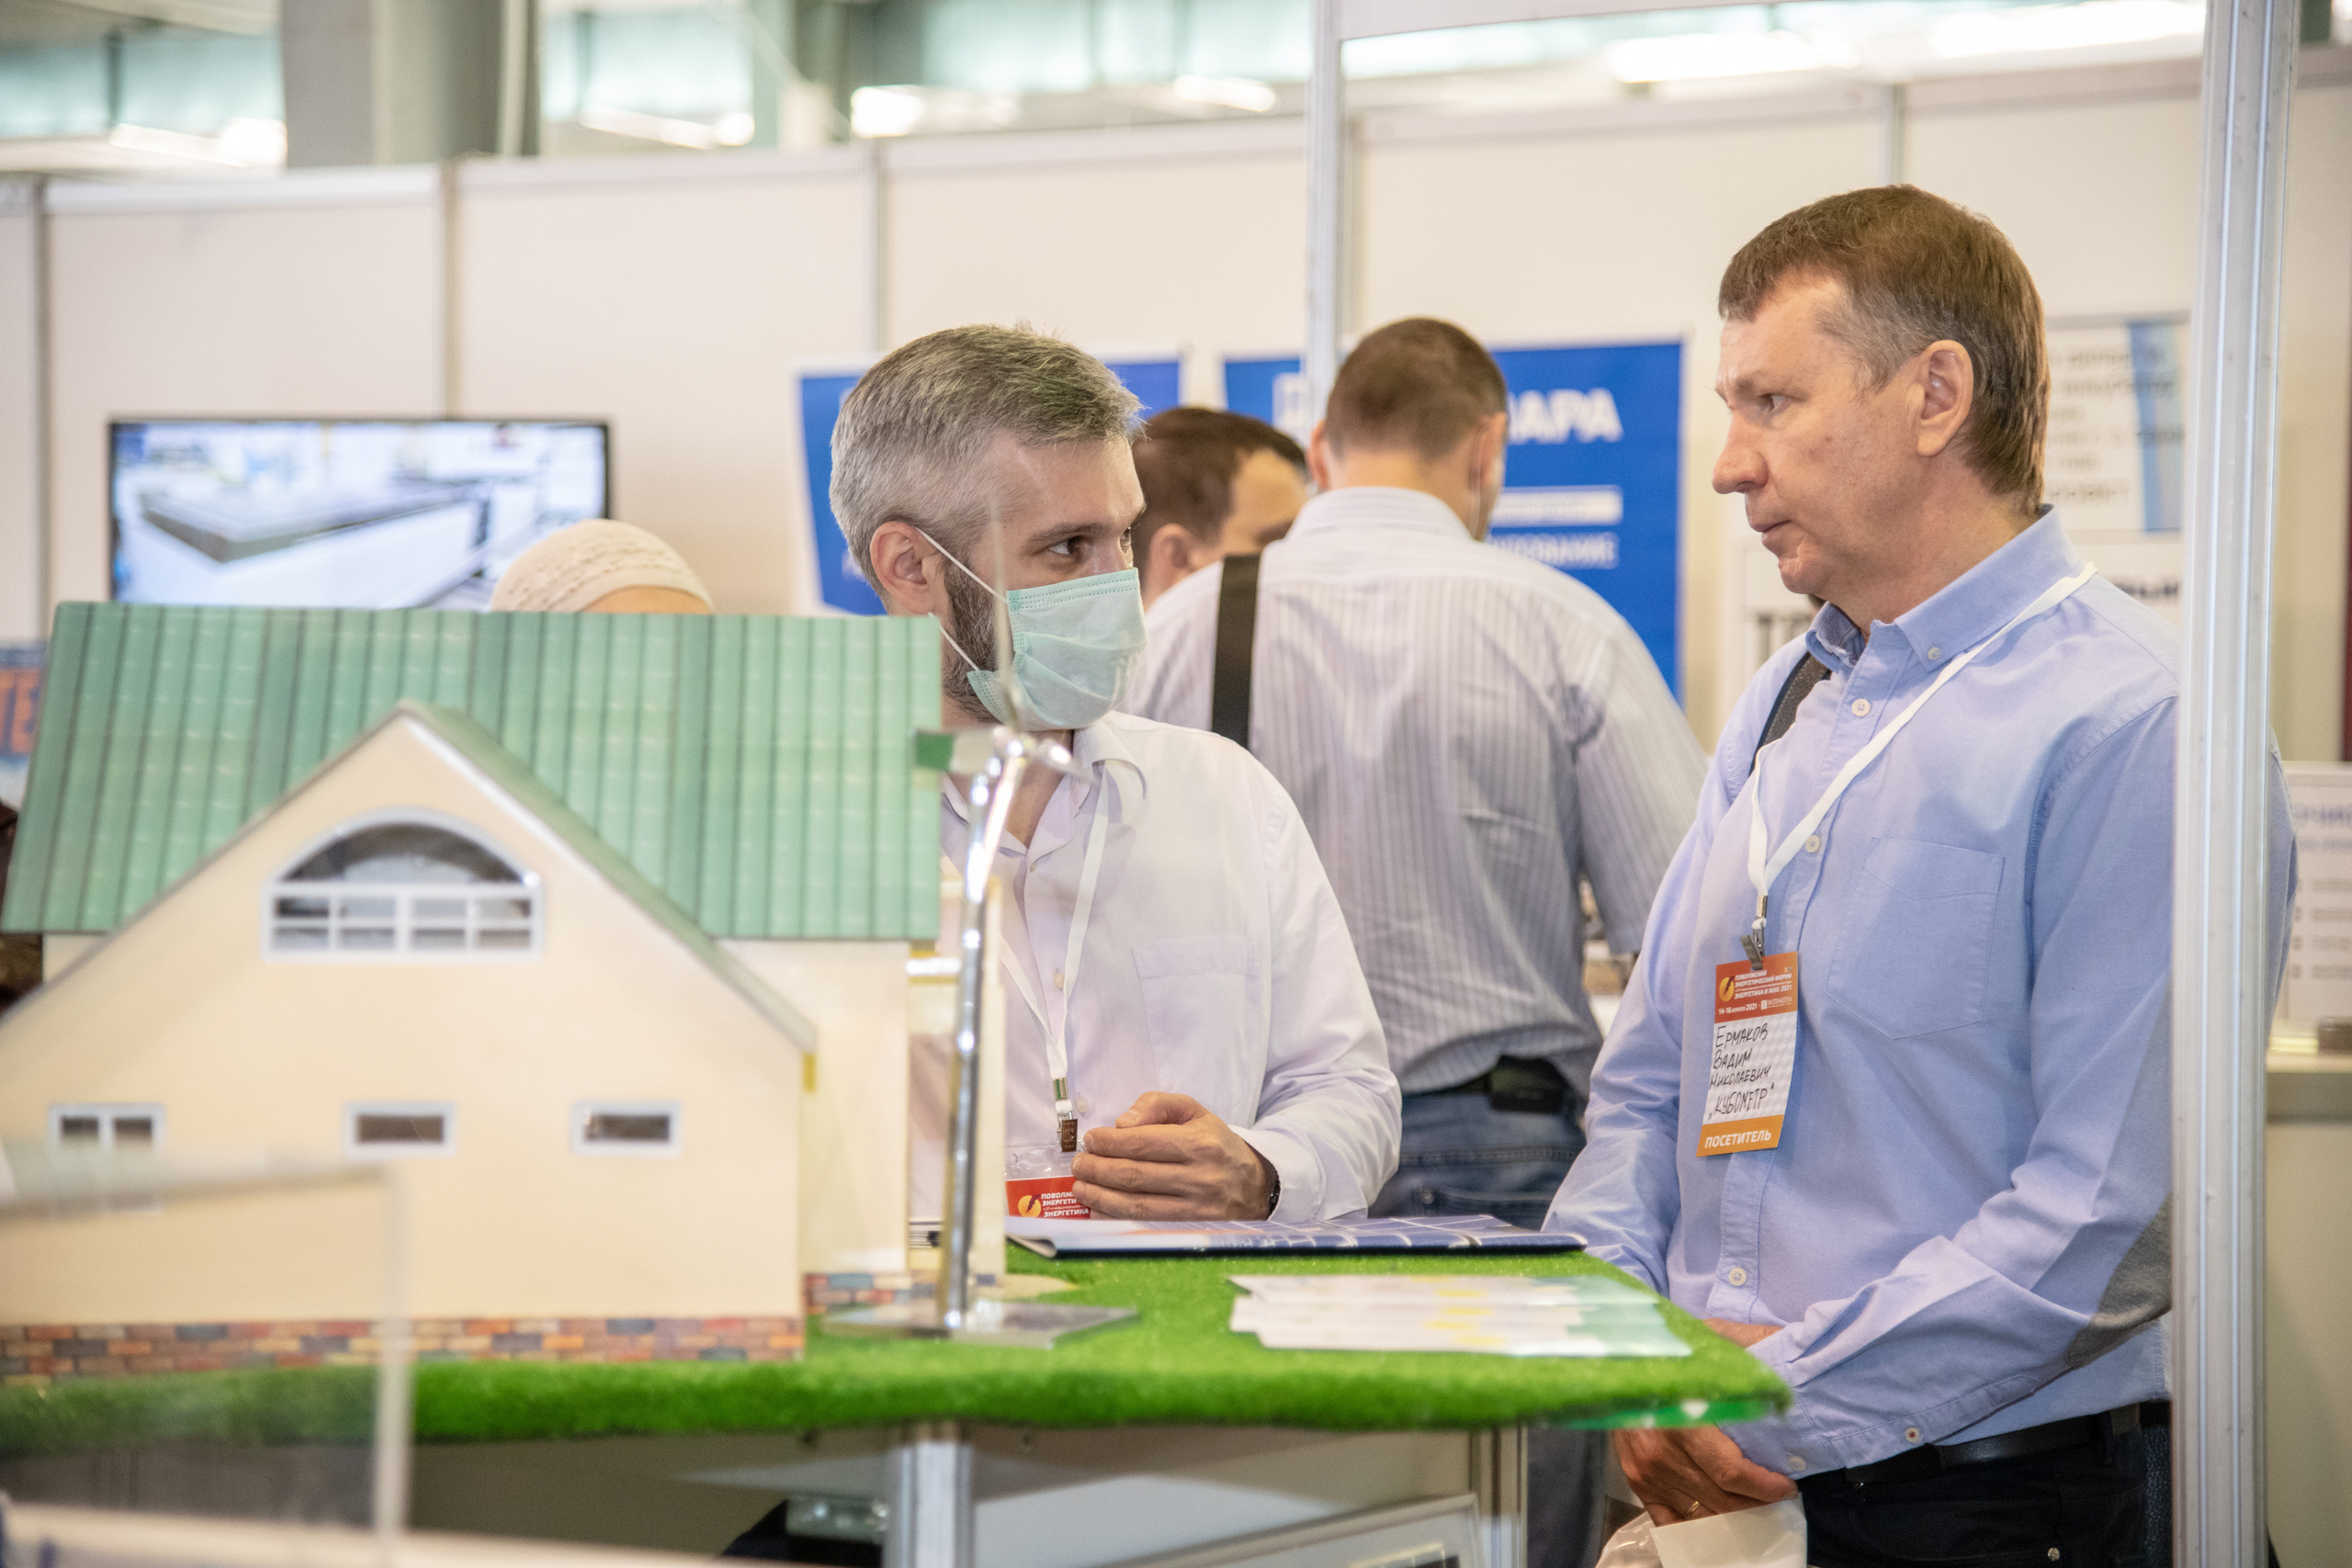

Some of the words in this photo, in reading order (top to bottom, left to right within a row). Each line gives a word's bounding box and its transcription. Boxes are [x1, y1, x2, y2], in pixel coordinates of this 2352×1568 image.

[1507, 388, 1623, 445] АРА
[1774, 973, 1792, 982] ФОРУМ
[1704, 1129, 1772, 1148] ПОСЕТИТЕЛЬ
[1044, 1208, 1089, 1217] ЭНЕРГЕТИКА
